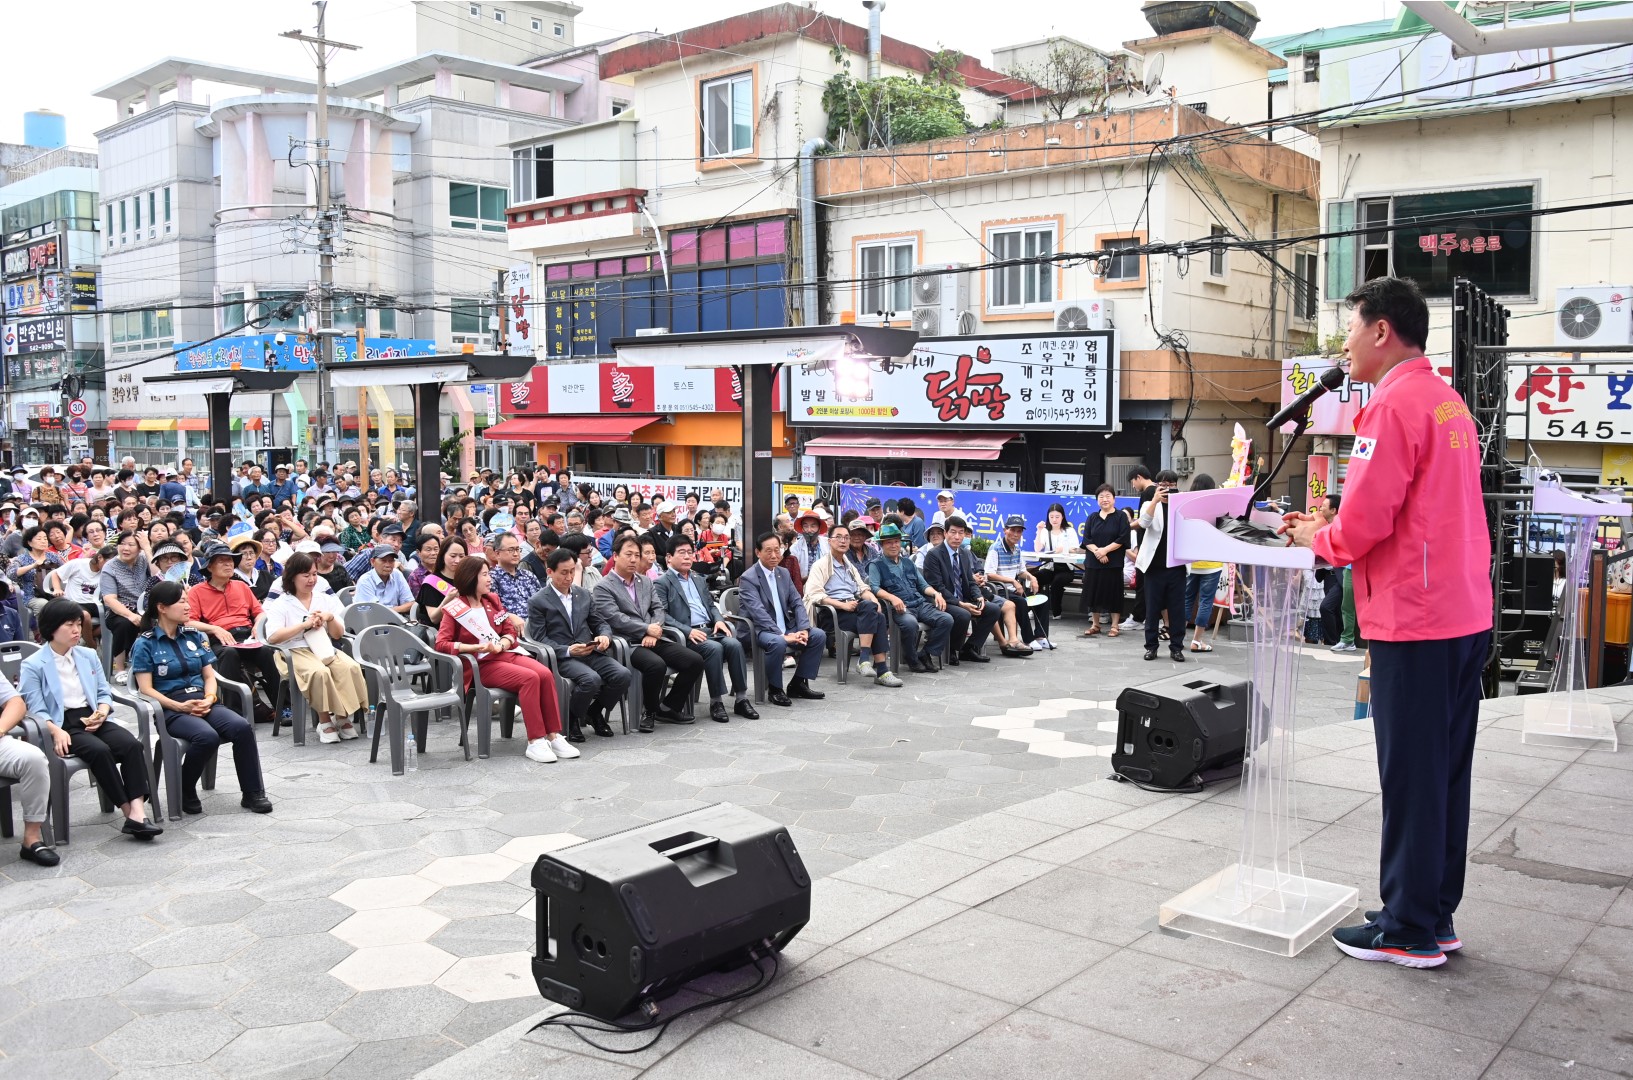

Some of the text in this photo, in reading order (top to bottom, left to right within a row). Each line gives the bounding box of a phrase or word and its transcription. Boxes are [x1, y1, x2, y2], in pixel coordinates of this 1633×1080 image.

[1418, 233, 1502, 256] 맥주&음료
[19, 320, 64, 343] 반송한의원
[1020, 342, 1033, 402] 조개탕
[1083, 340, 1098, 402] 영계통구이
[562, 384, 585, 393] 계란만두
[673, 381, 694, 391] 토스트
[923, 353, 1011, 421] 닭발
[1034, 407, 1097, 421] (051)545-9393
[976, 503, 998, 514] 2024
